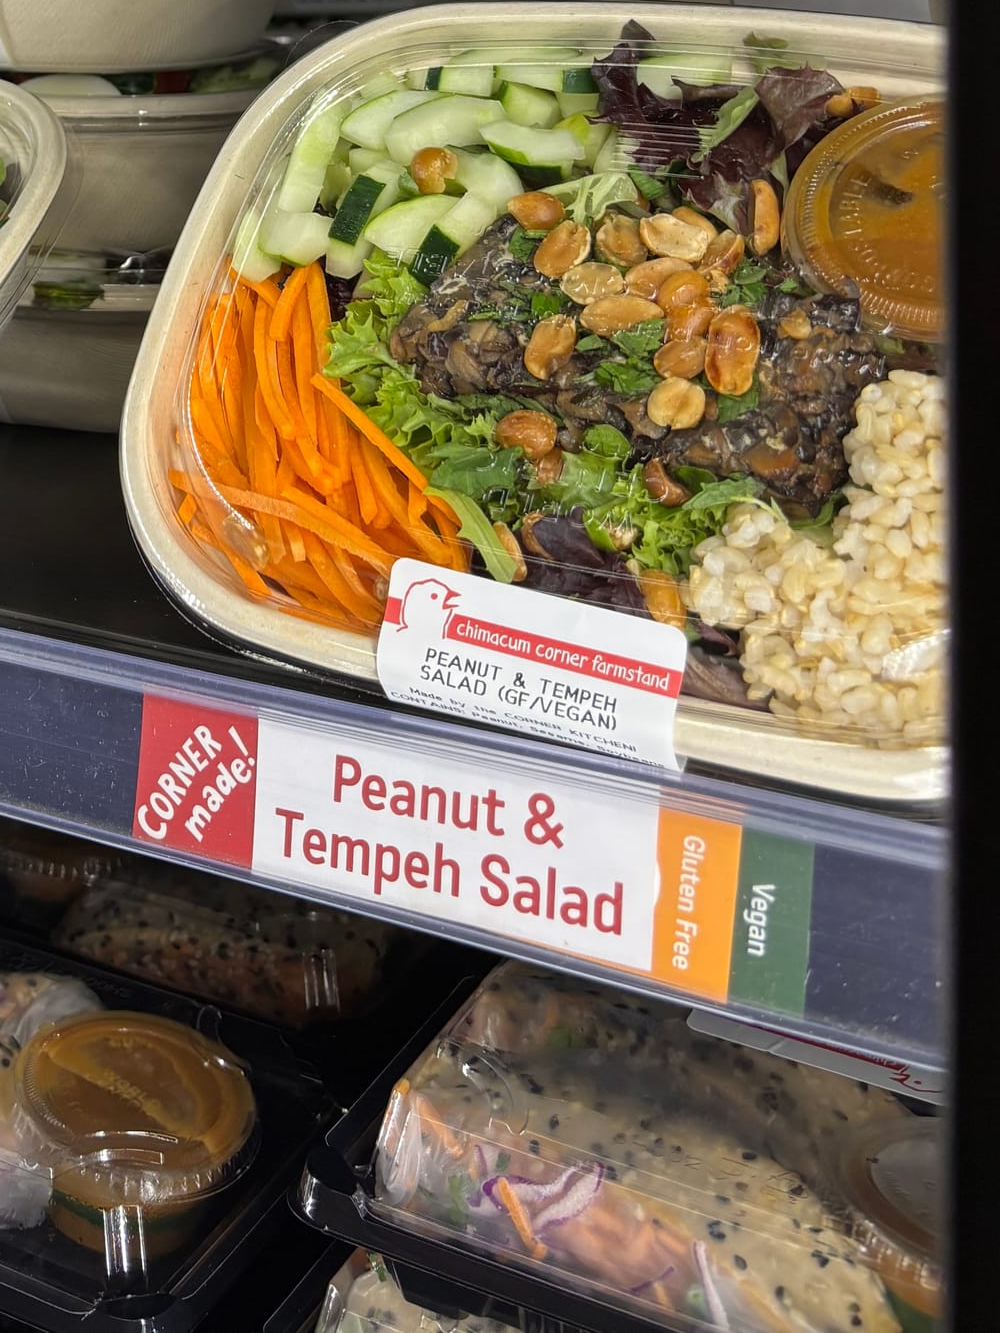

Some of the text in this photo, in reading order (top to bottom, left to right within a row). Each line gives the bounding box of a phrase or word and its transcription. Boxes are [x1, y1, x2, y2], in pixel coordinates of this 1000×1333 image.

[420, 666, 618, 731] SALAD (GF/VEGAN)
[425, 648, 617, 714] PEANUT & TEMPEH
[456, 621, 671, 691] chimacum corner farmstand
[409, 687, 443, 702] Made
[449, 696, 465, 709] by
[474, 702, 496, 715] the
[504, 712, 562, 731] CORNER
[136, 724, 223, 841] CORNER
[184, 726, 257, 843] made!
[333, 753, 565, 849] Peanut &
[274, 807, 624, 937] Tempeh Salad
[671, 834, 705, 971] Gluten Free
[744, 883, 776, 959] Vegan
